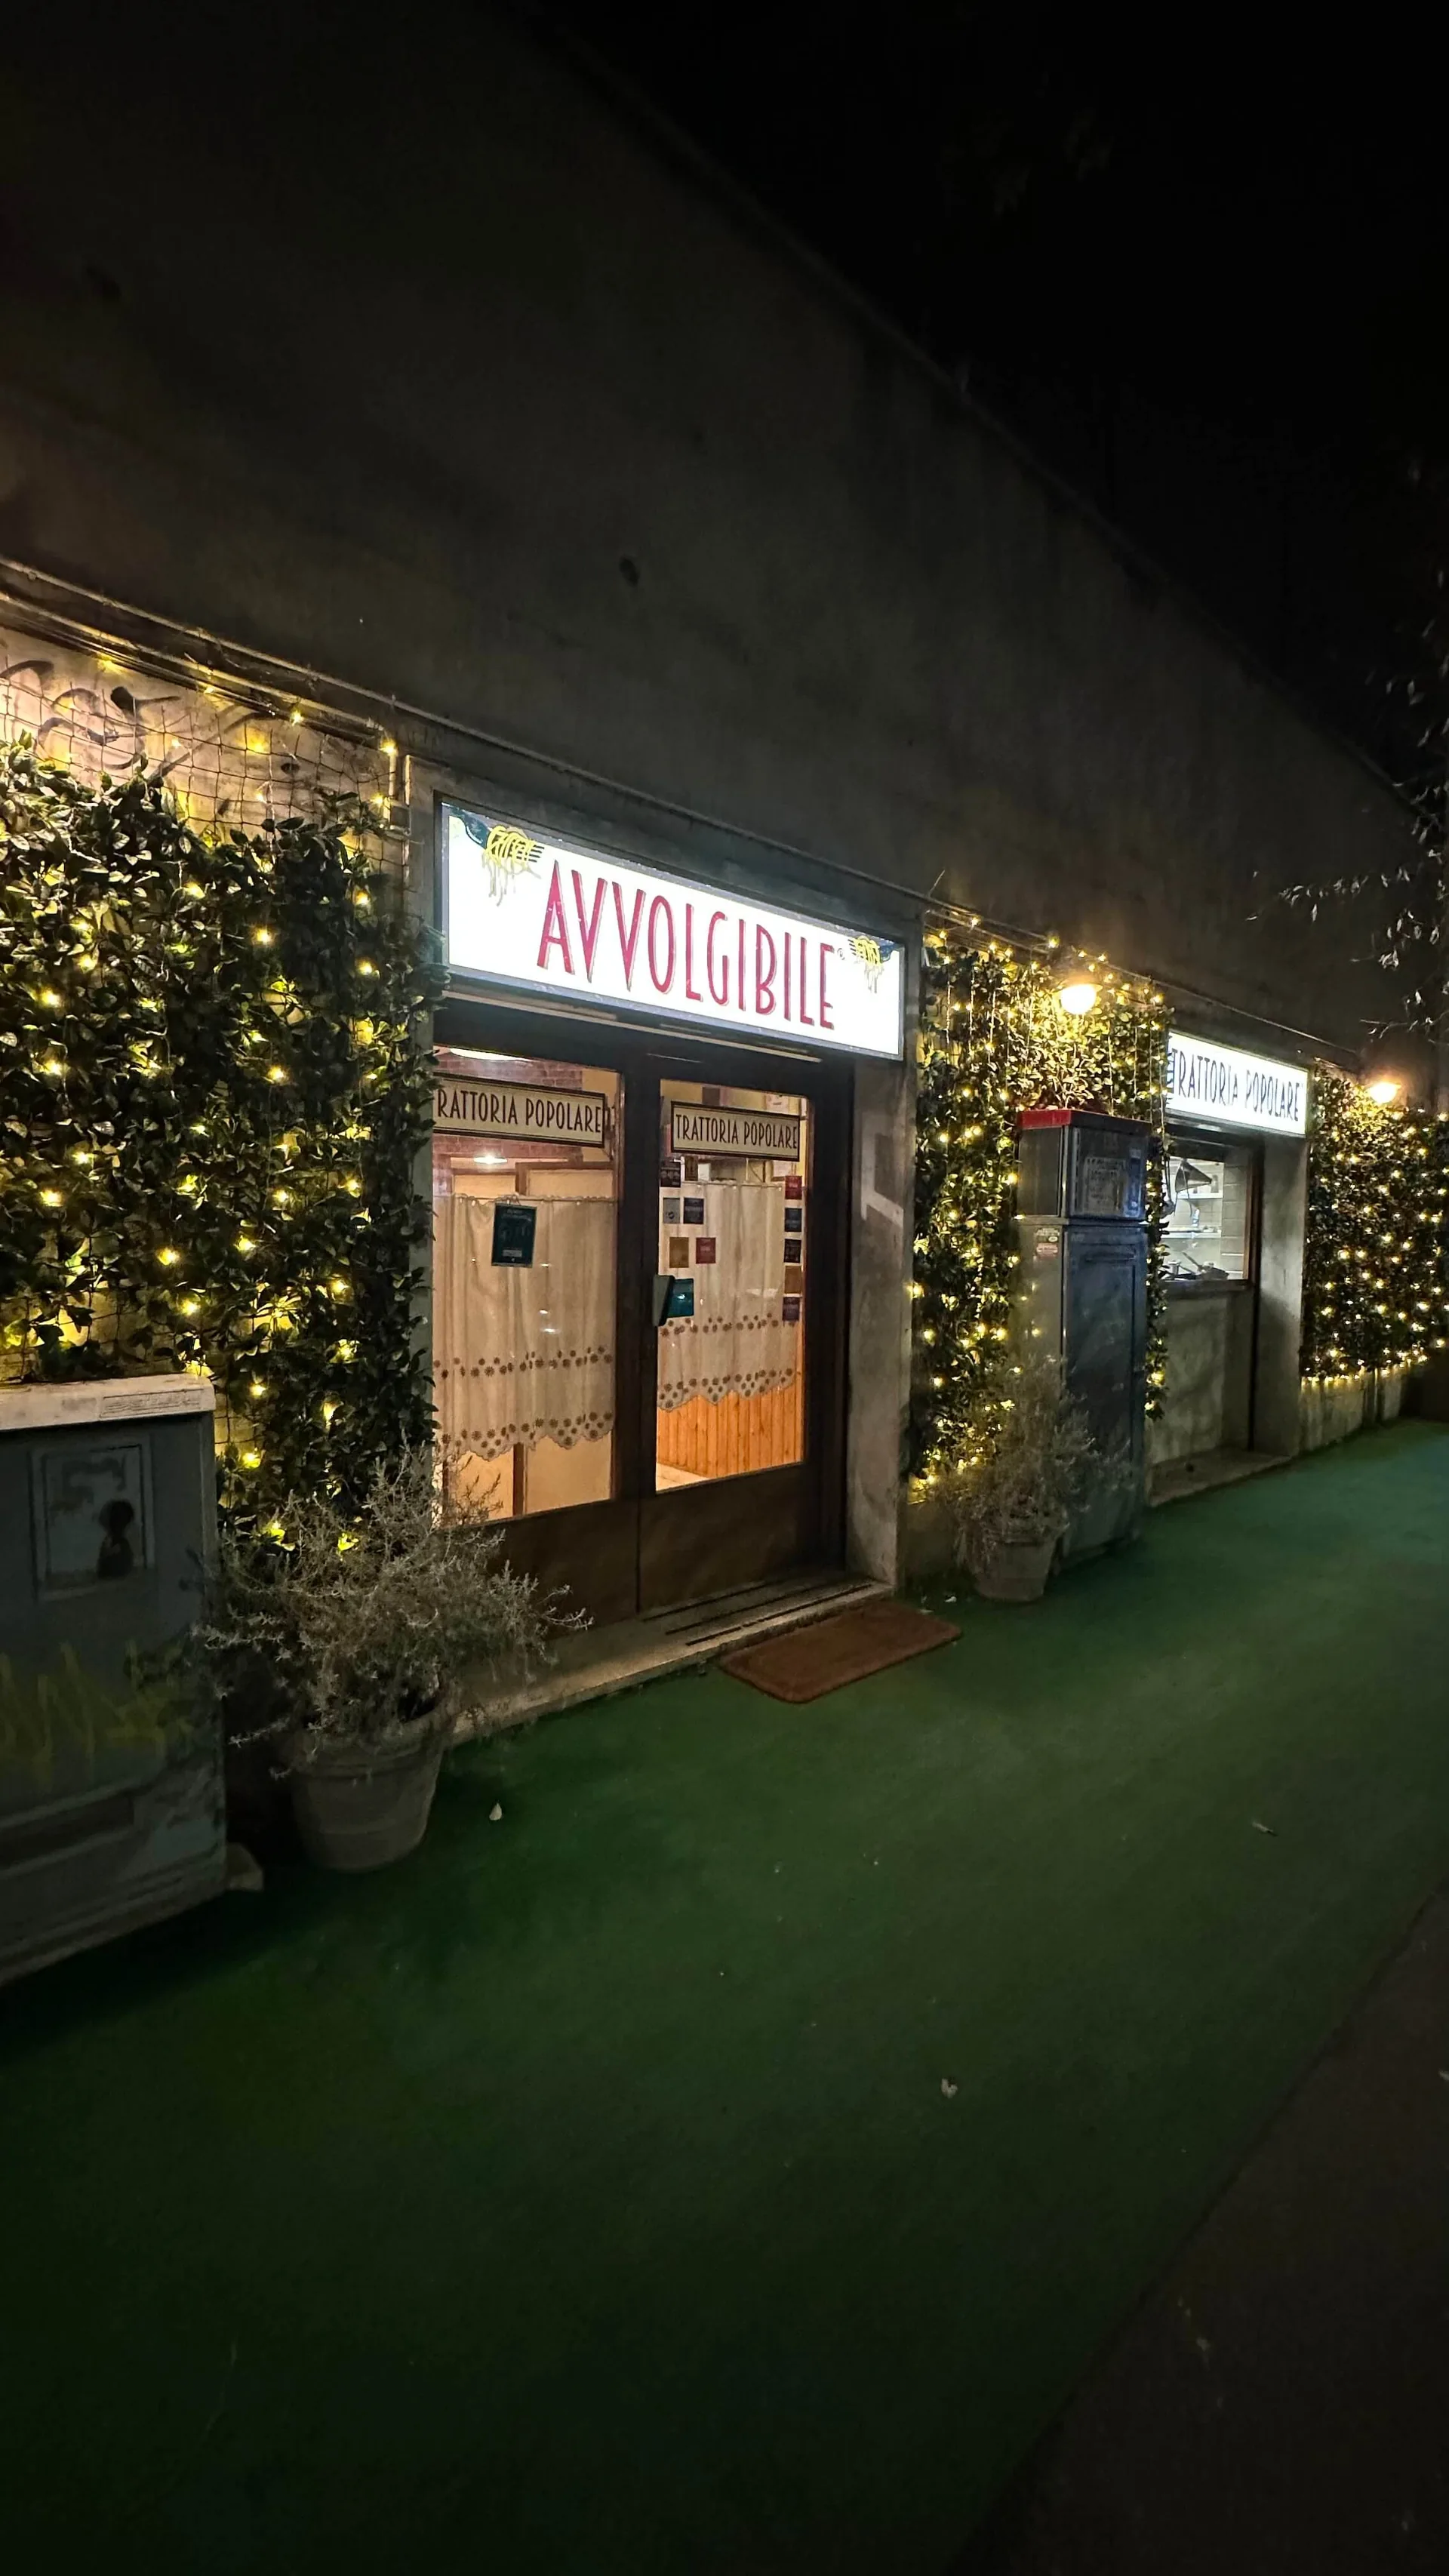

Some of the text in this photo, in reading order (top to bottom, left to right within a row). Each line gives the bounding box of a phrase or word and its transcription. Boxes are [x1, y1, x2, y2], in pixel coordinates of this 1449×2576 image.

[537, 859, 835, 1030] AVVOLGIBILE
[437, 1088, 602, 1134] RATTORIA POPOLARE
[1171, 1048, 1300, 1122] TRATTORIA POPOLARE
[675, 1114, 798, 1150] TRATTORIA POPOLARE
